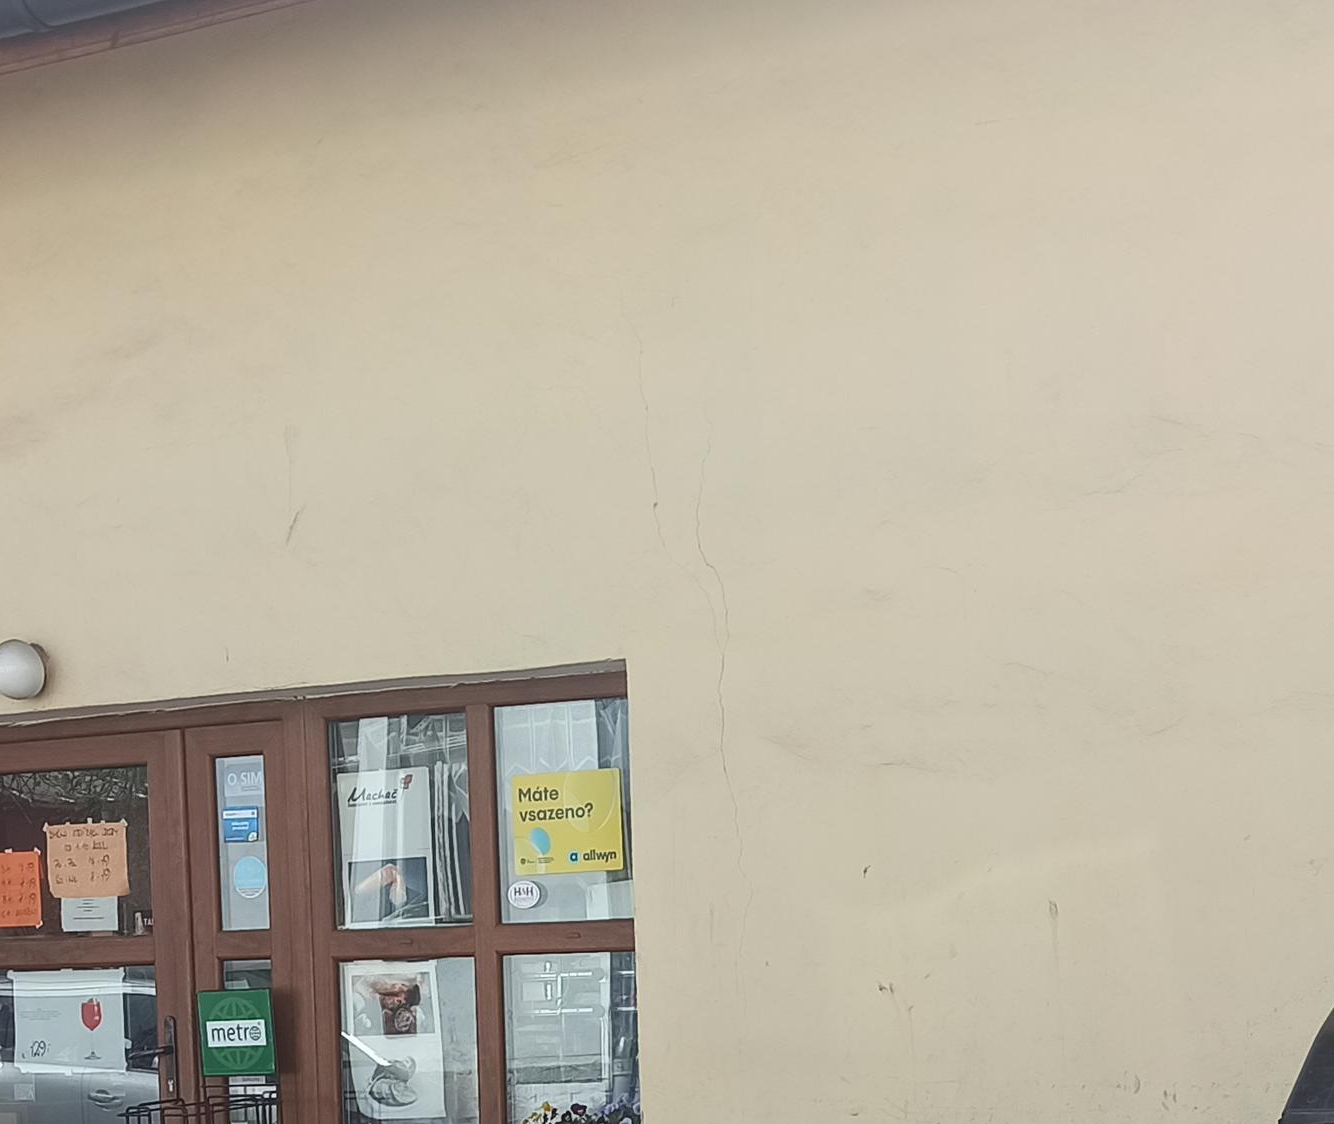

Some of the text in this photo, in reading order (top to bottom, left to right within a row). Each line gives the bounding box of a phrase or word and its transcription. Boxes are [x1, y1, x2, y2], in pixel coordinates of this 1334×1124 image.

[518, 786, 559, 803] Máte
[519, 802, 594, 822] vsazeno?
[582, 849, 617, 863] allwyn
[211, 1025, 262, 1042] metro
